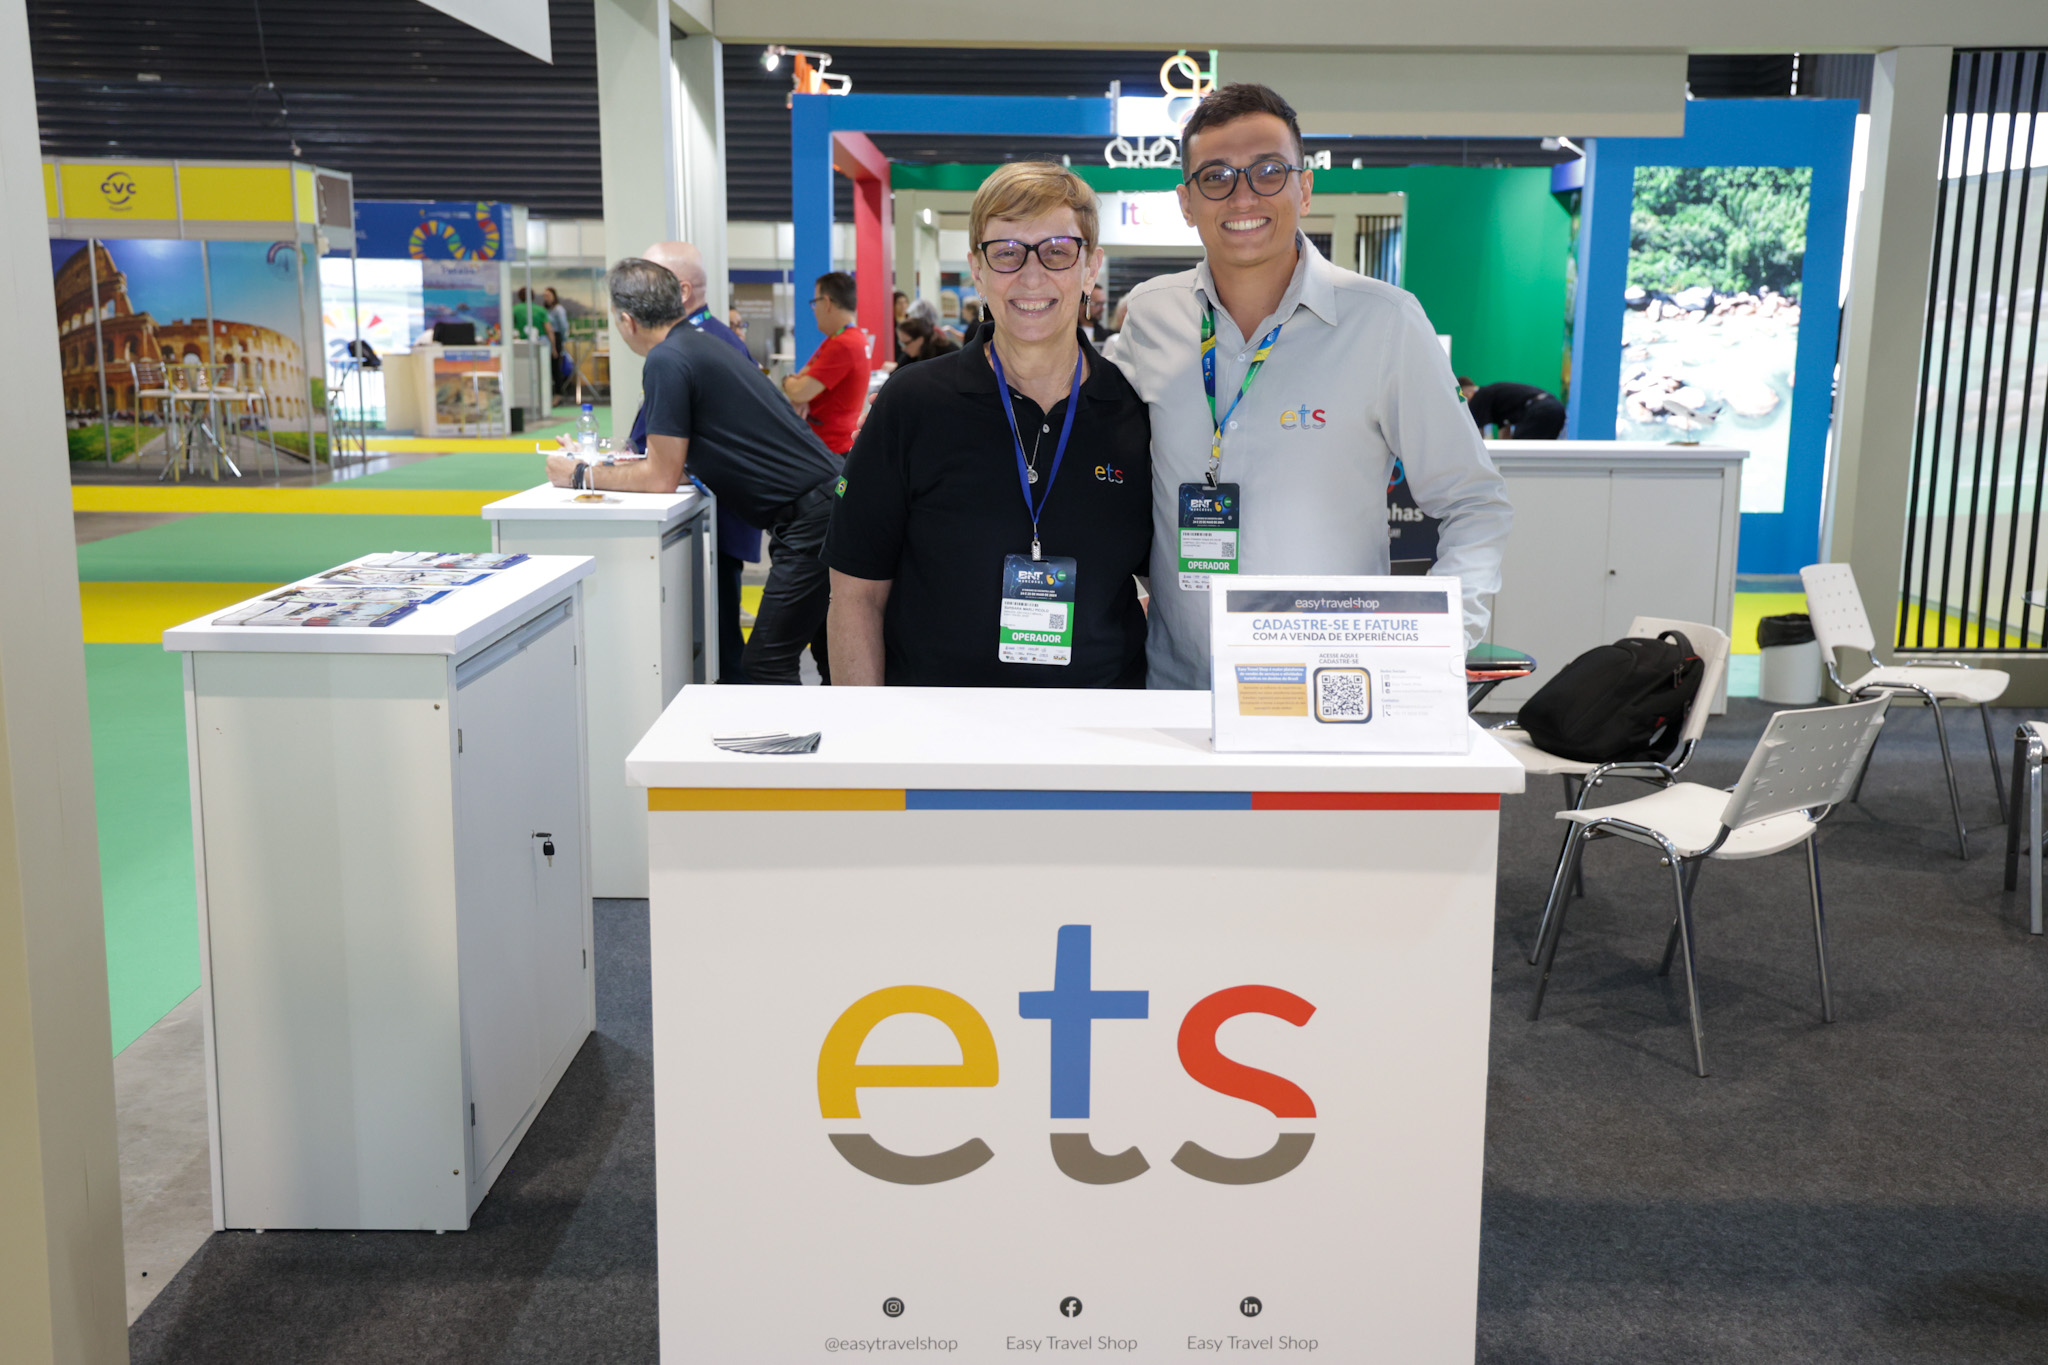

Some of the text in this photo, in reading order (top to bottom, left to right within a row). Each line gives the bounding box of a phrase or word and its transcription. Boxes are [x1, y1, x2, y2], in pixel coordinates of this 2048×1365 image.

[101, 182, 136, 194] CVC
[1280, 404, 1326, 430] ets
[1095, 463, 1124, 484] ets
[1188, 561, 1229, 570] OPERADOR
[1252, 618, 1419, 631] CADASTRE-SE E FATURE
[1012, 632, 1061, 643] OPERADOR
[1252, 631, 1419, 642] COM A VENDA DE EXPERIÊNCIAS
[816, 924, 1318, 1186] ets
[824, 1336, 958, 1353] @easytravelshop
[1006, 1336, 1138, 1353] Easy Travel Shop
[1187, 1336, 1319, 1353] Easy Travel Shop
